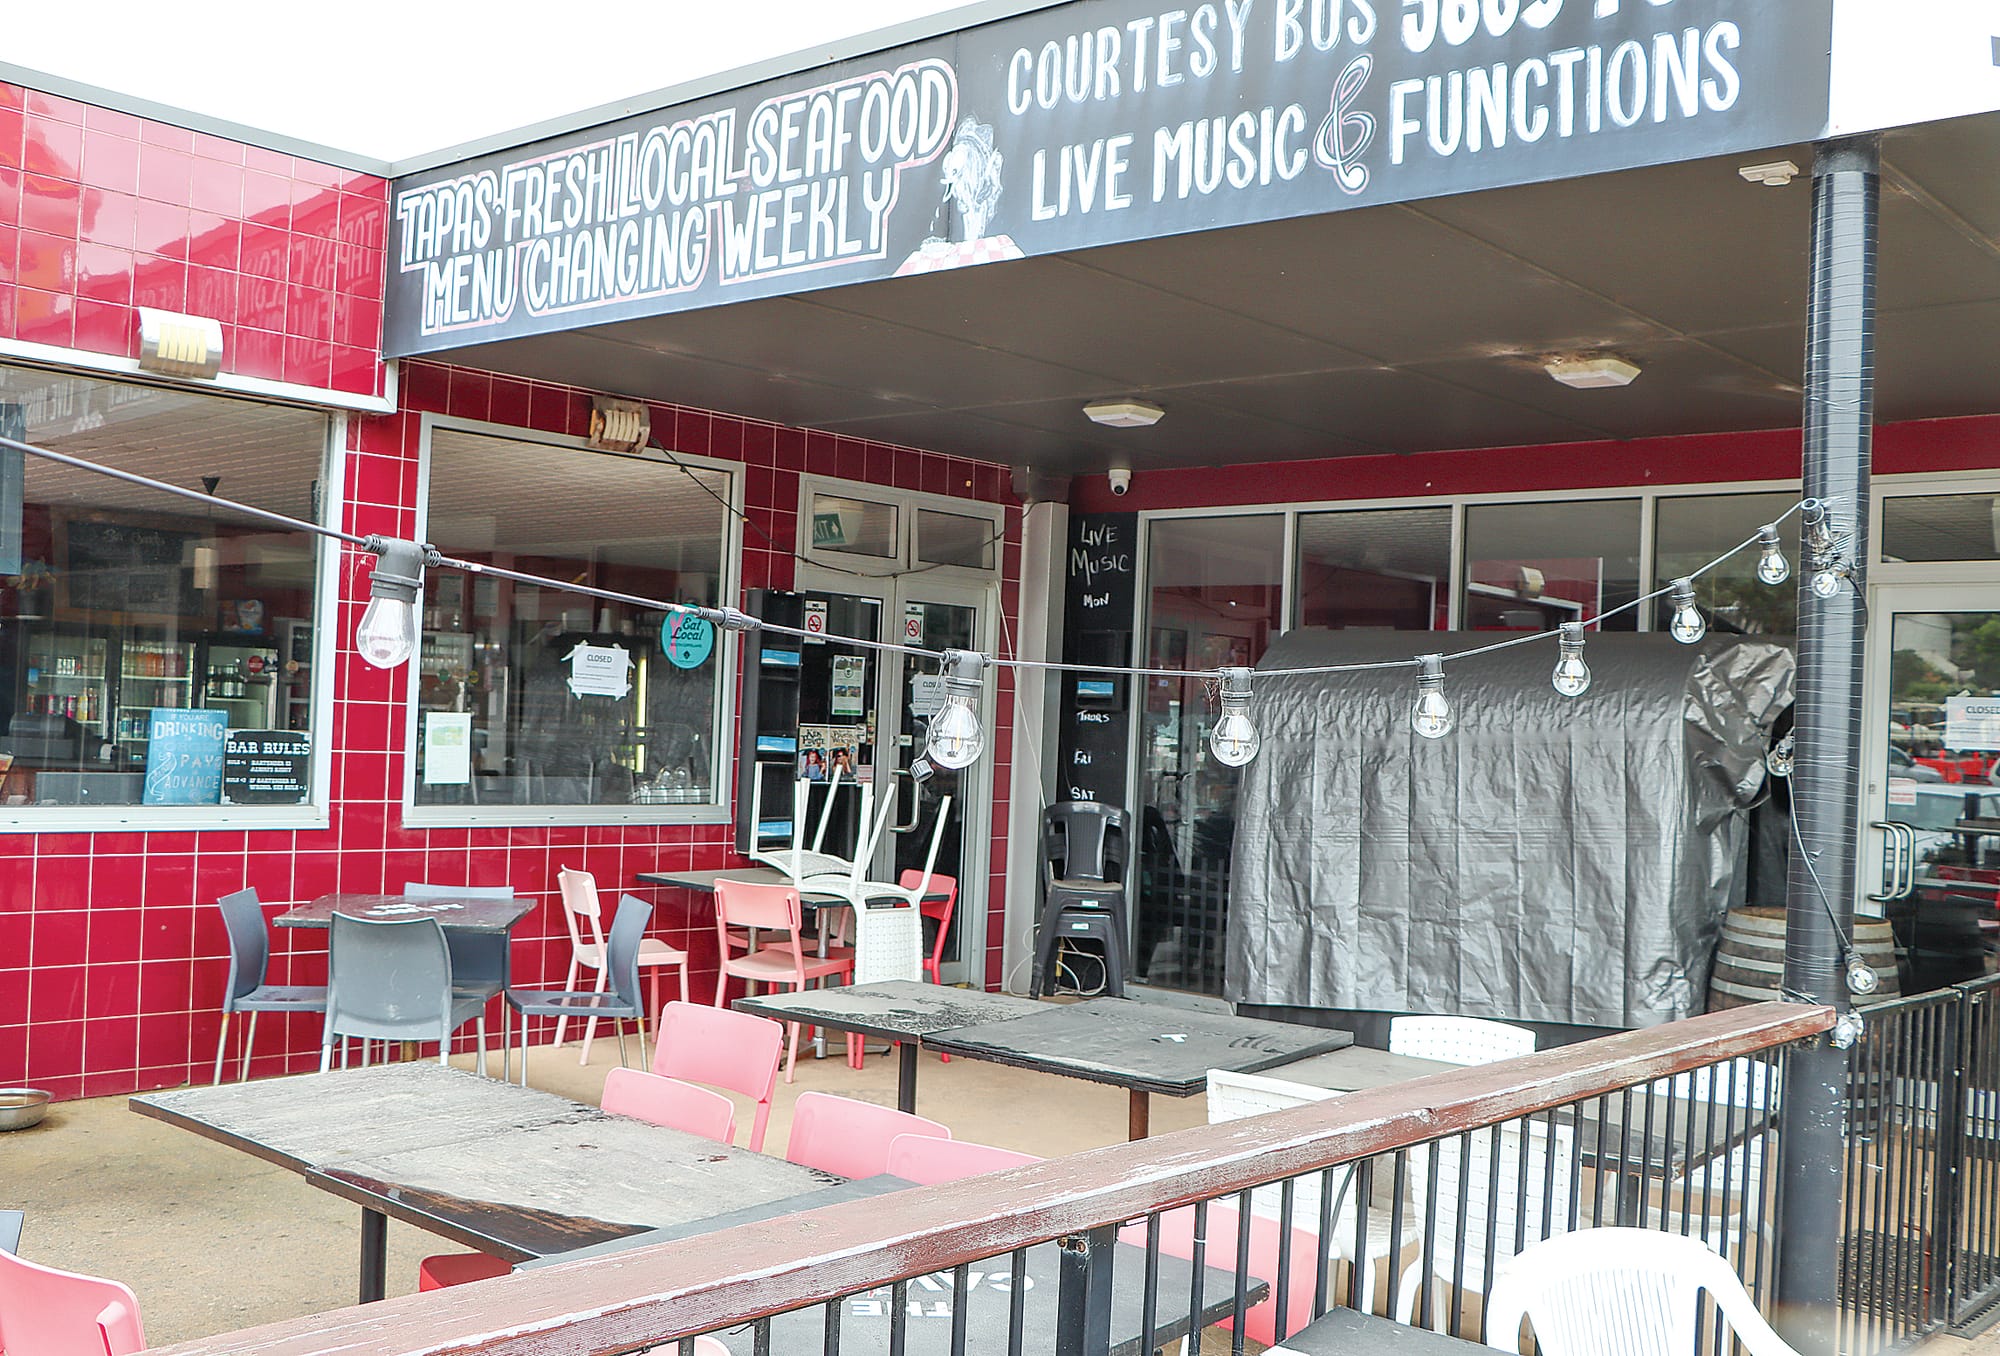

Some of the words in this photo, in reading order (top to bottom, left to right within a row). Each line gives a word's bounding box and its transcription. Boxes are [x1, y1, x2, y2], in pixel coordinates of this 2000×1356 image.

[1007, 1, 1251, 116] COURTESY
[1275, 0, 1375, 62] BUS
[1390, 20, 1740, 166] FUNCTIONS
[504, 149, 609, 242] FRESH
[618, 119, 738, 219] LOCAL
[750, 70, 949, 187] SEAFOOD
[1031, 133, 1134, 221] LIVE
[1152, 103, 1309, 202] MUSIC
[425, 245, 514, 327] MENU
[528, 211, 704, 304] CHANGING
[723, 168, 892, 275] WEEKLY
[1081, 520, 1119, 546] LIVE
[1072, 547, 1130, 587] MUSIC
[1083, 592, 1109, 608] MON
[683, 617, 702, 630] Eat
[671, 627, 705, 641] Local
[586, 654, 613, 664] CLOSED
[154, 721, 224, 741] DRINKING
[227, 741, 259, 754] BAR
[262, 742, 311, 755] RULES
[1073, 750, 1092, 764] FRI
[164, 775, 221, 789] ADVANCE
[1071, 786, 1095, 800] SAT
